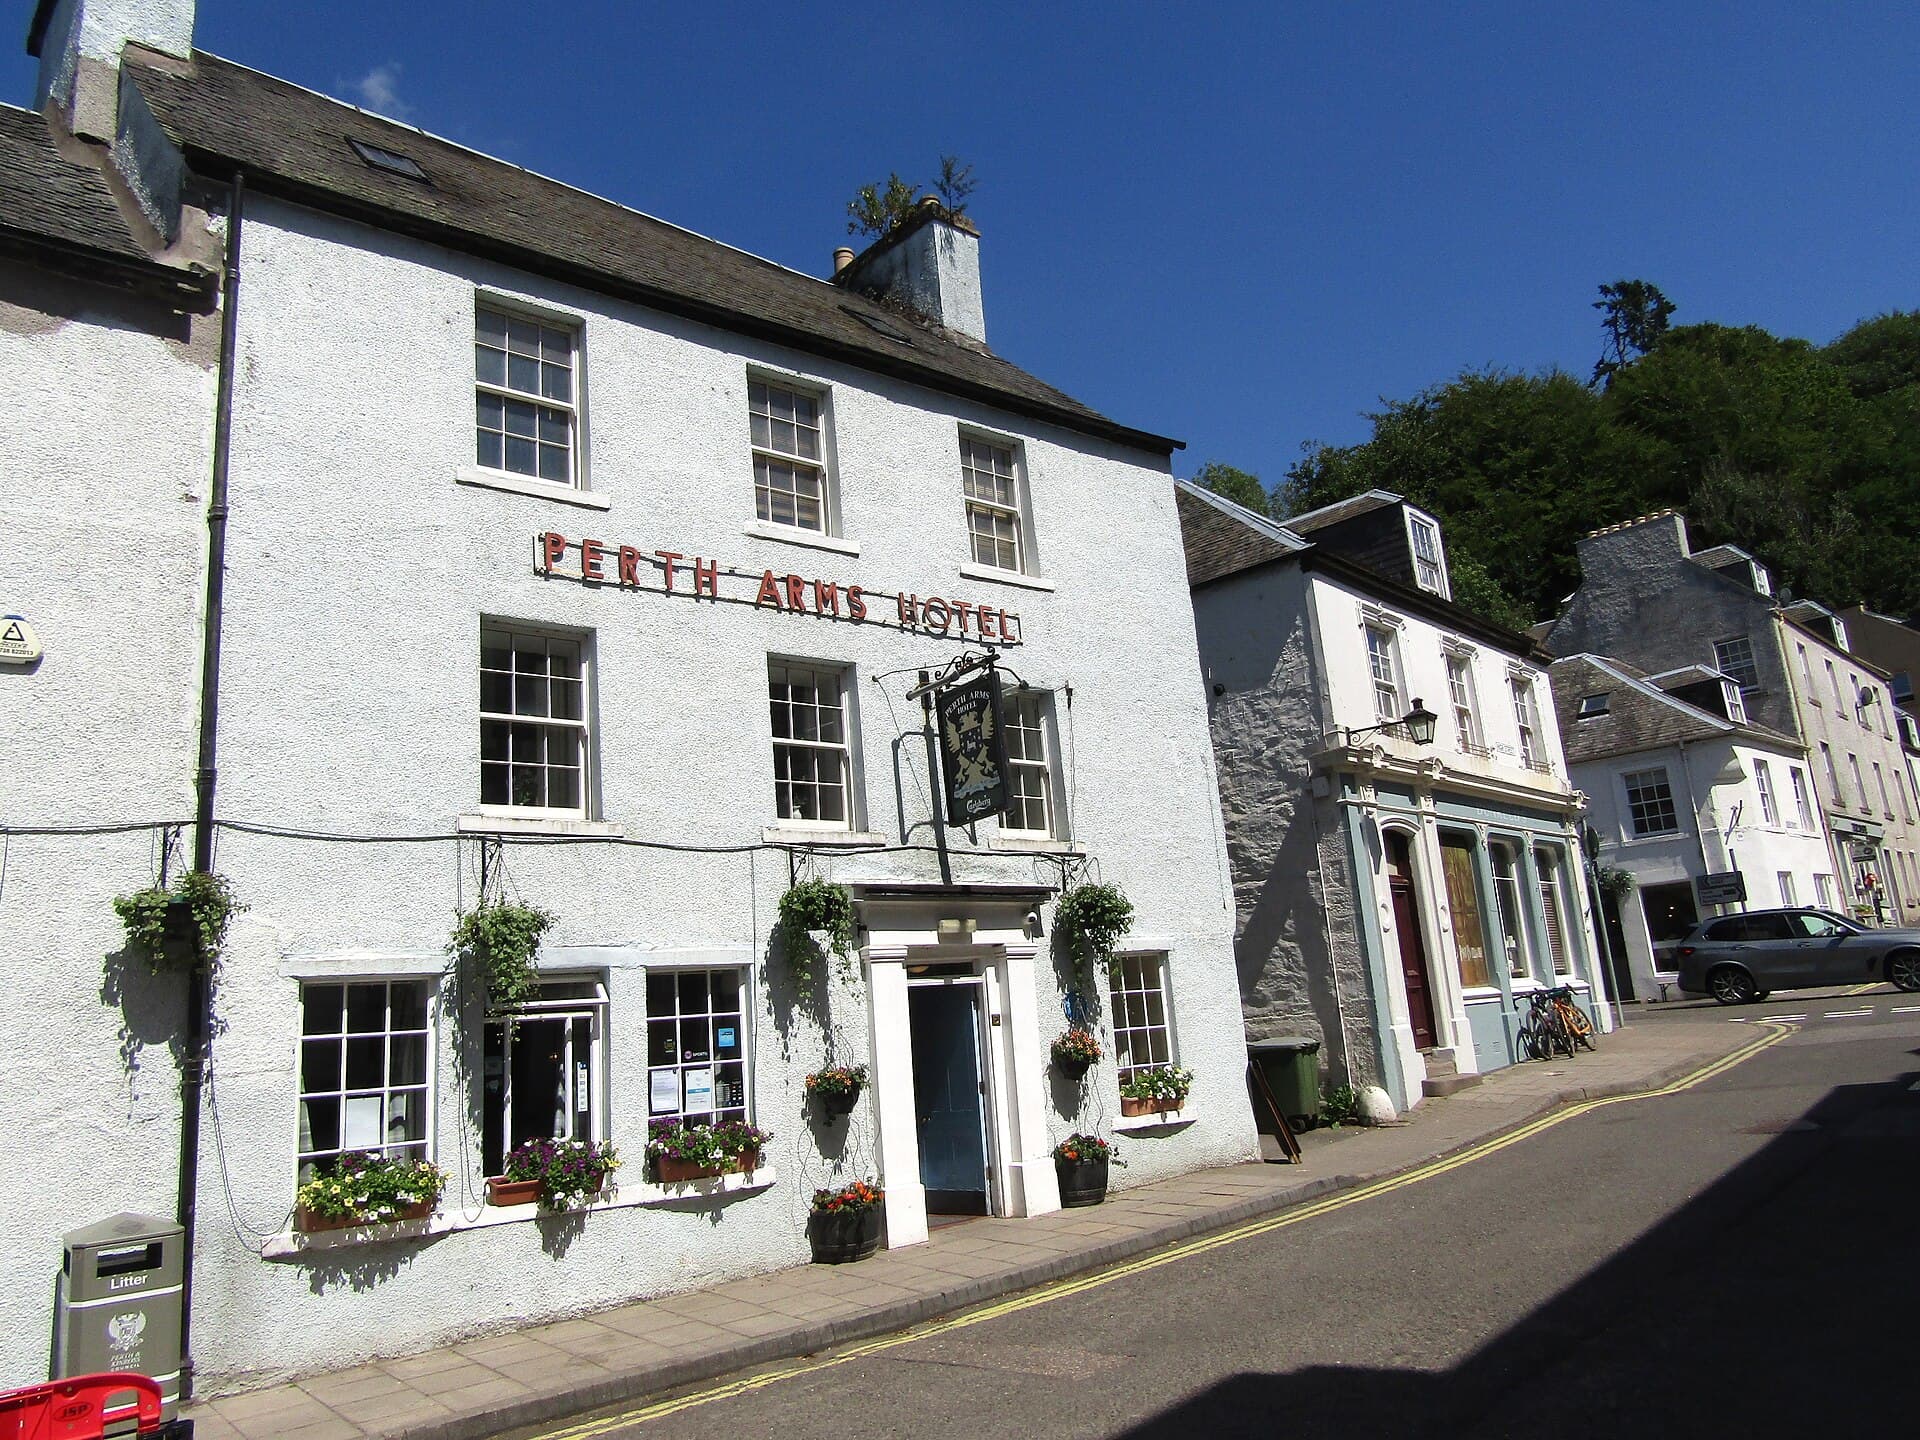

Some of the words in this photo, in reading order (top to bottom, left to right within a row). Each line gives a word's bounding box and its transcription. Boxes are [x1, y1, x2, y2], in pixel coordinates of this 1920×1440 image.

[543, 531, 718, 597] PERTH
[755, 569, 867, 620] ARMS
[897, 591, 1017, 642] HOTEL
[944, 694, 967, 717] PERTH
[969, 690, 990, 700] ARMS
[957, 700, 977, 715] HOTEL
[966, 798, 991, 814] Carlsberg
[110, 1274, 148, 1290] Litter
